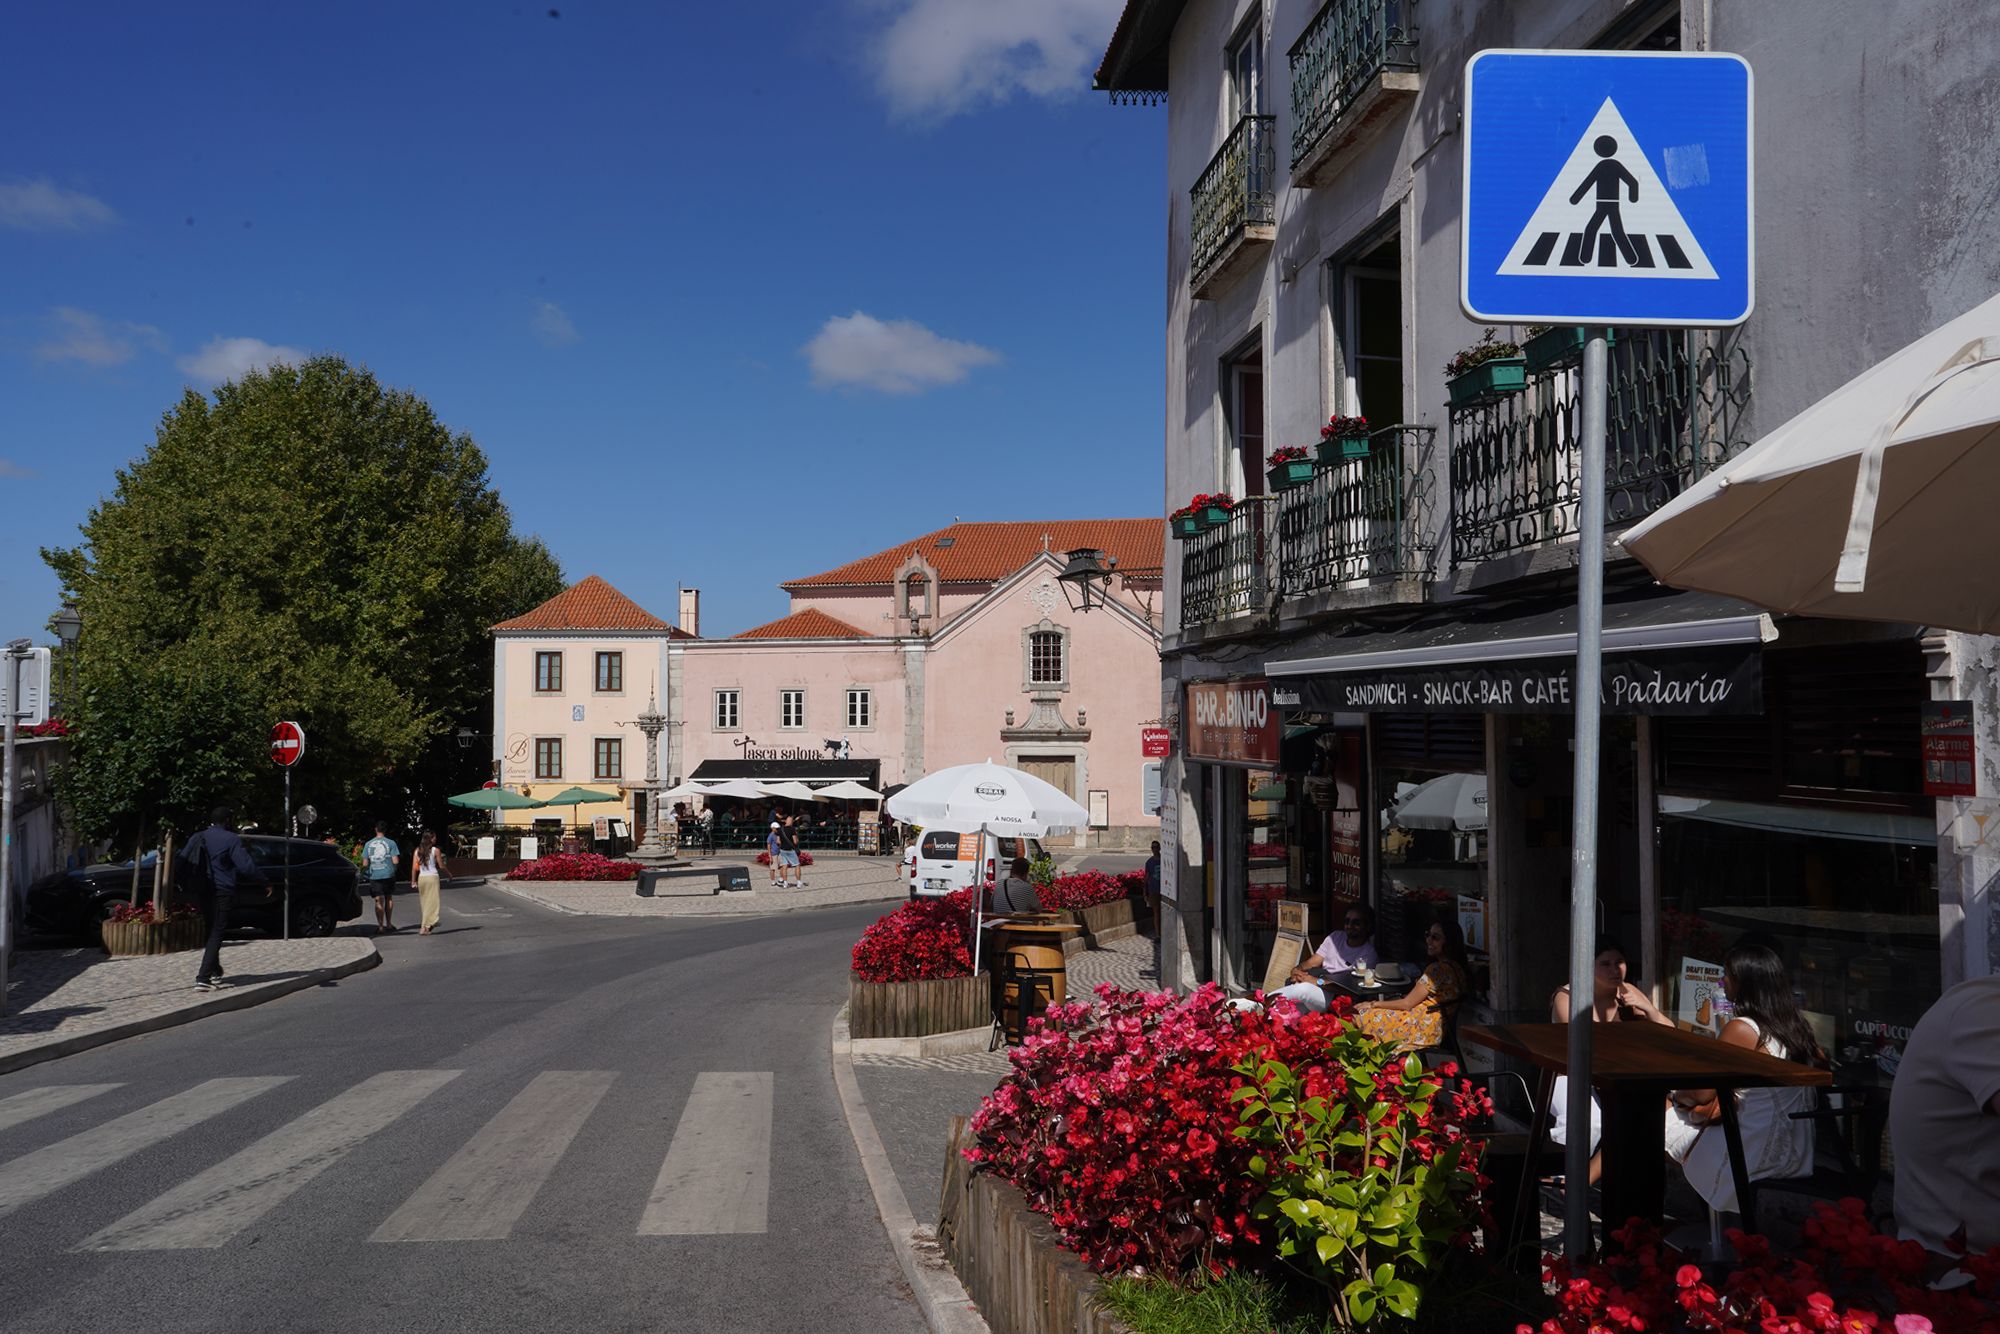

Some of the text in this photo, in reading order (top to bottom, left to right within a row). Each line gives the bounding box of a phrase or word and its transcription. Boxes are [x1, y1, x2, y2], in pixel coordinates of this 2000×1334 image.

[1344, 683, 1407, 706] SANDWICH
[1423, 680, 1513, 705] SNACK-BAR
[1522, 669, 1570, 704] CAFÉ
[1195, 690, 1219, 727] BAR
[1226, 688, 1267, 730] BINHO
[733, 735, 777, 760] Tasca
[1926, 736, 1969, 751] Alarme
[1332, 851, 1360, 869] VINTAGE
[1686, 965, 1719, 976] DRAFT BEER
